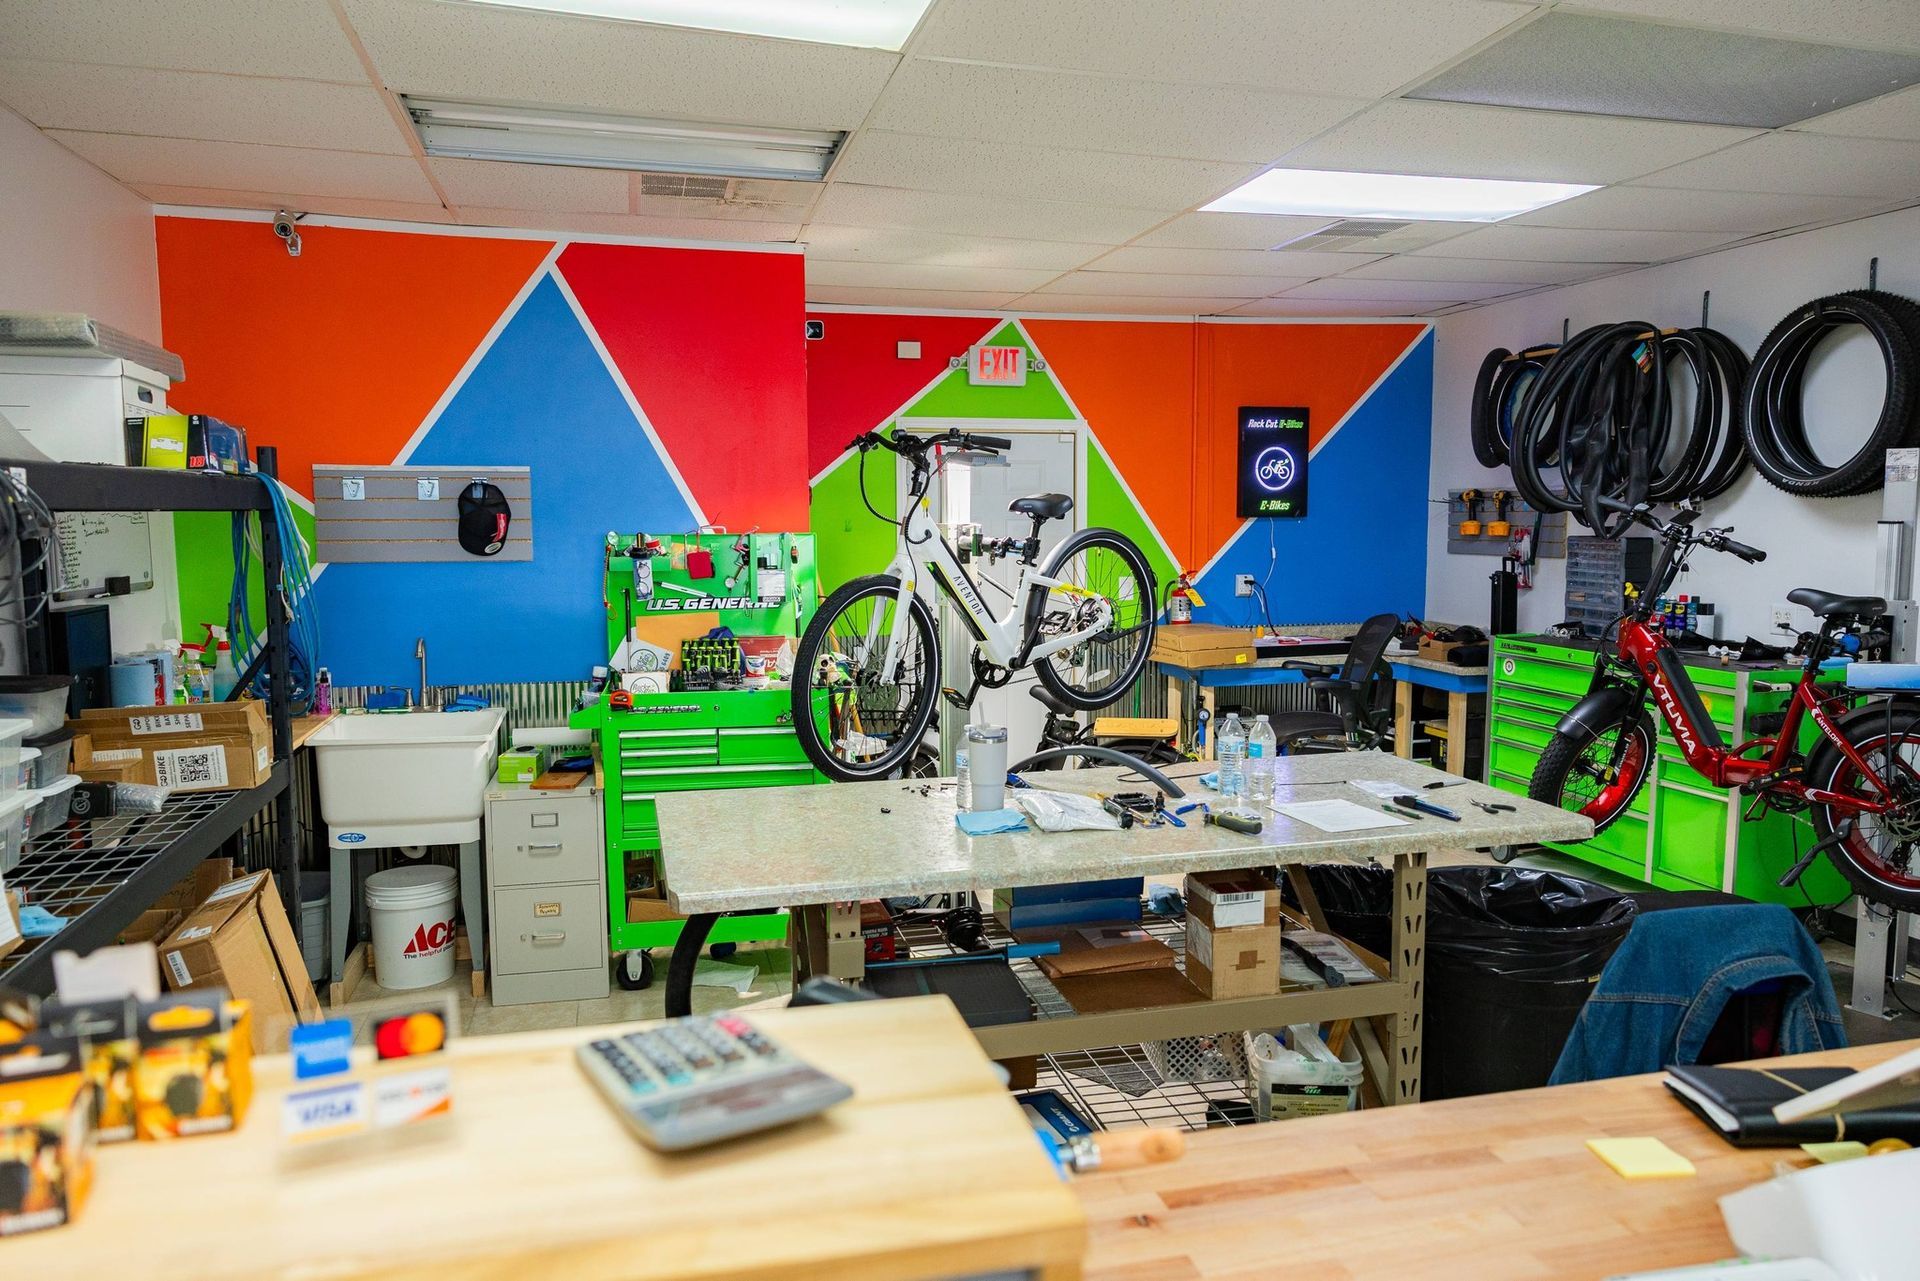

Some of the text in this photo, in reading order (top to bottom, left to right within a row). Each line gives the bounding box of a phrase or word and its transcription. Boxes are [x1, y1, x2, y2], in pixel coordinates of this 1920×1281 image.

[979, 348, 1020, 379] EXIT
[1248, 419, 1265, 428] Rock
[1265, 419, 1278, 428] Cut
[1260, 500, 1291, 510] E-Bikes
[646, 598, 681, 611] U.S.
[953, 575, 984, 615] AVENTON
[1653, 673, 1696, 755] VTUVIA
[1816, 717, 1843, 747] ANTELOPE
[403, 917, 456, 953] ACE
